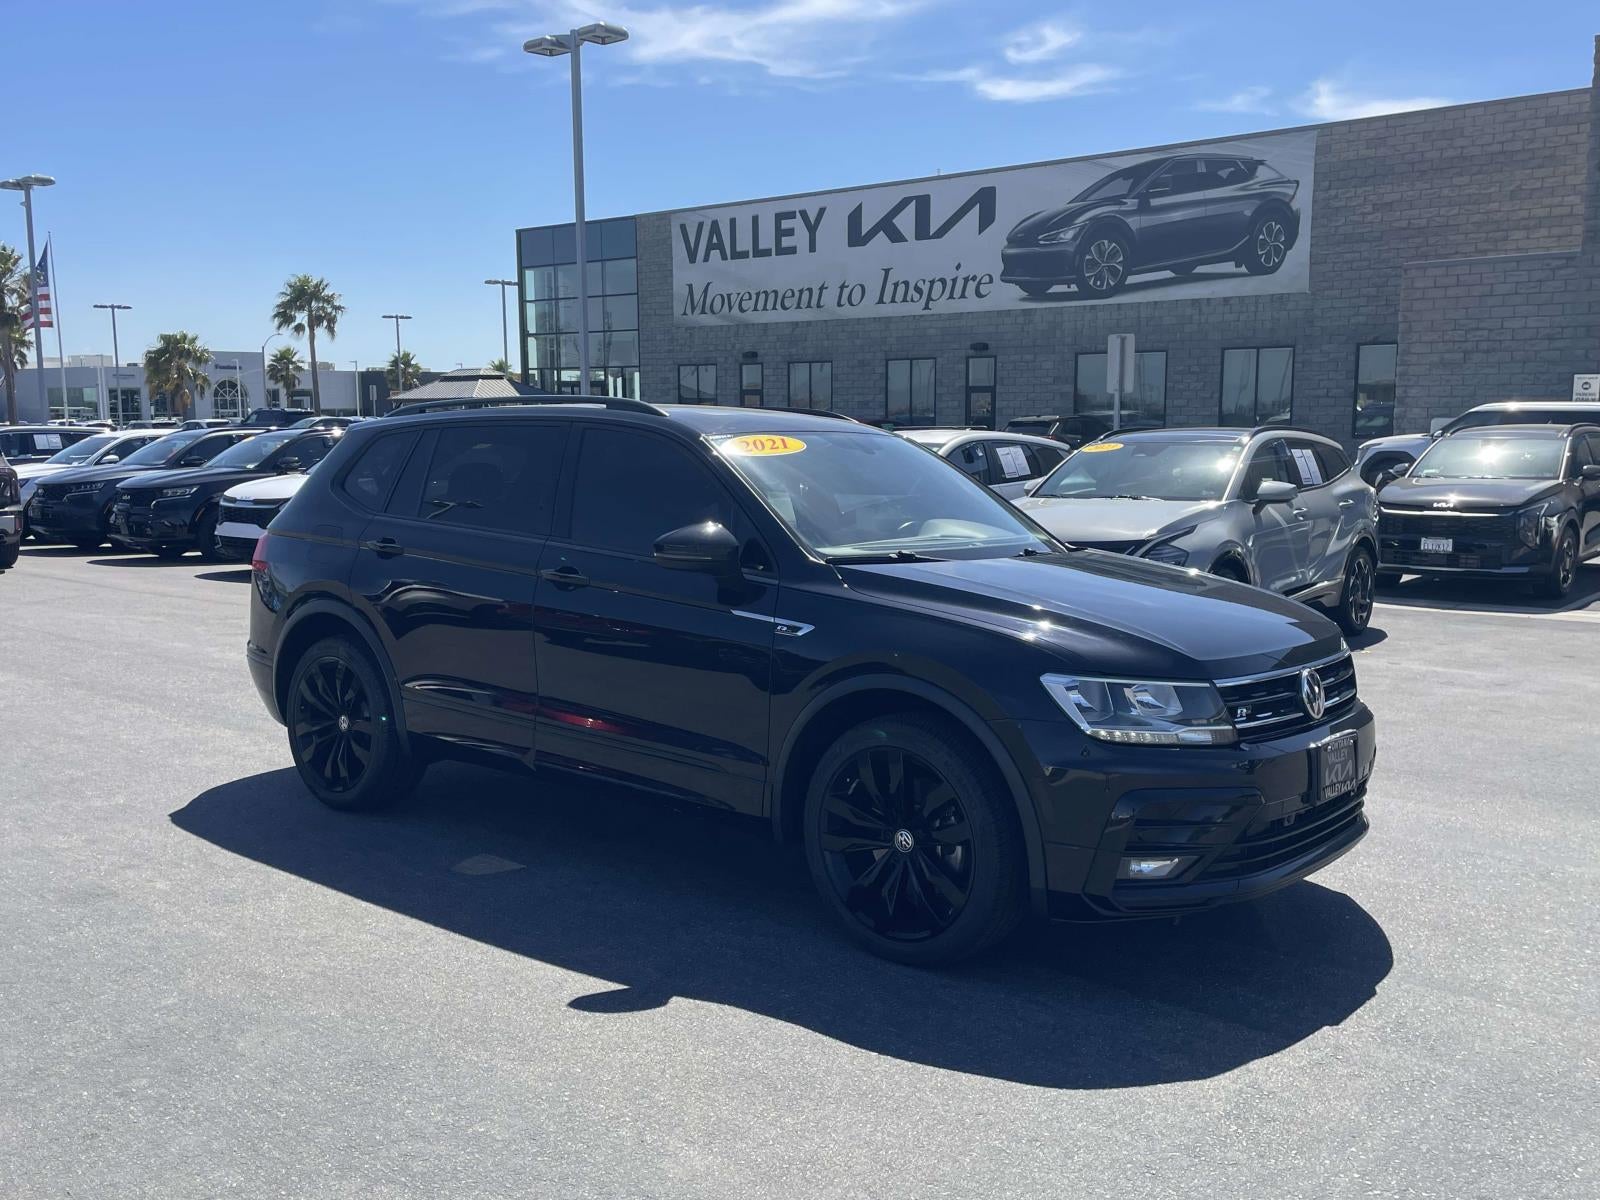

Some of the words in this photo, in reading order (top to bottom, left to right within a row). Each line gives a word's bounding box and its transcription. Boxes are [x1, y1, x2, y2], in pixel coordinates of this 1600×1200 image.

[679, 206, 827, 264] VALLEY
[847, 186, 996, 247] KIA
[681, 281, 828, 316] Movement
[836, 280, 866, 308] to
[875, 262, 994, 311] Inspire
[741, 438, 789, 452] 2021
